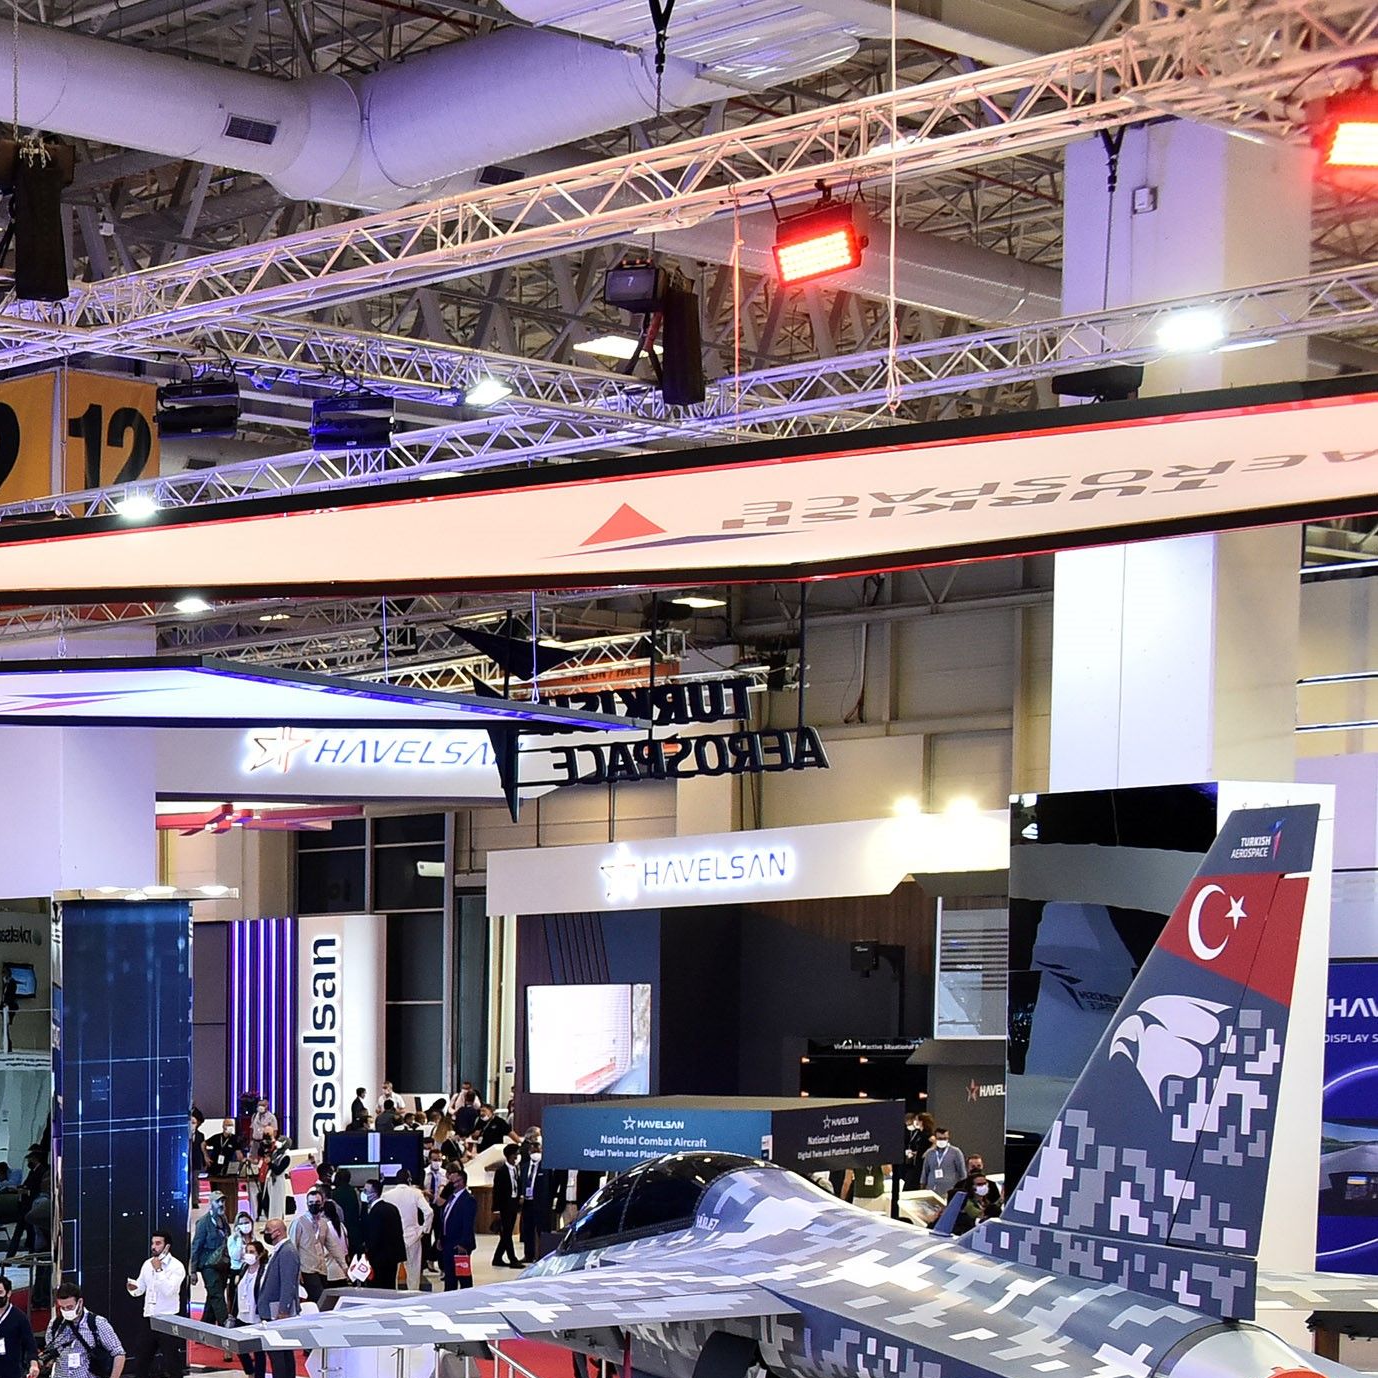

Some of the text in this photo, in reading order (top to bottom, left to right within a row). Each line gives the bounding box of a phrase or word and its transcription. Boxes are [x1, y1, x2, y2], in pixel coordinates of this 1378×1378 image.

[69, 403, 151, 512] 12
[722, 479, 1219, 529] TURKISH
[315, 738, 504, 765] HAVELSA
[1240, 835, 1272, 847] TURKISH
[1230, 846, 1269, 859] AEROSPACE
[644, 851, 786, 887] HAVELSAN
[1324, 1033, 1370, 1043] DISPLAY
[979, 1083, 1005, 1097] HAVEL
[637, 1120, 685, 1130] HAVELSAN
[600, 1134, 707, 1148] National Combat Aircraft
[583, 1148, 606, 1159] Digital
[607, 1149, 625, 1158] Twin
[625, 1150, 639, 1158] and
